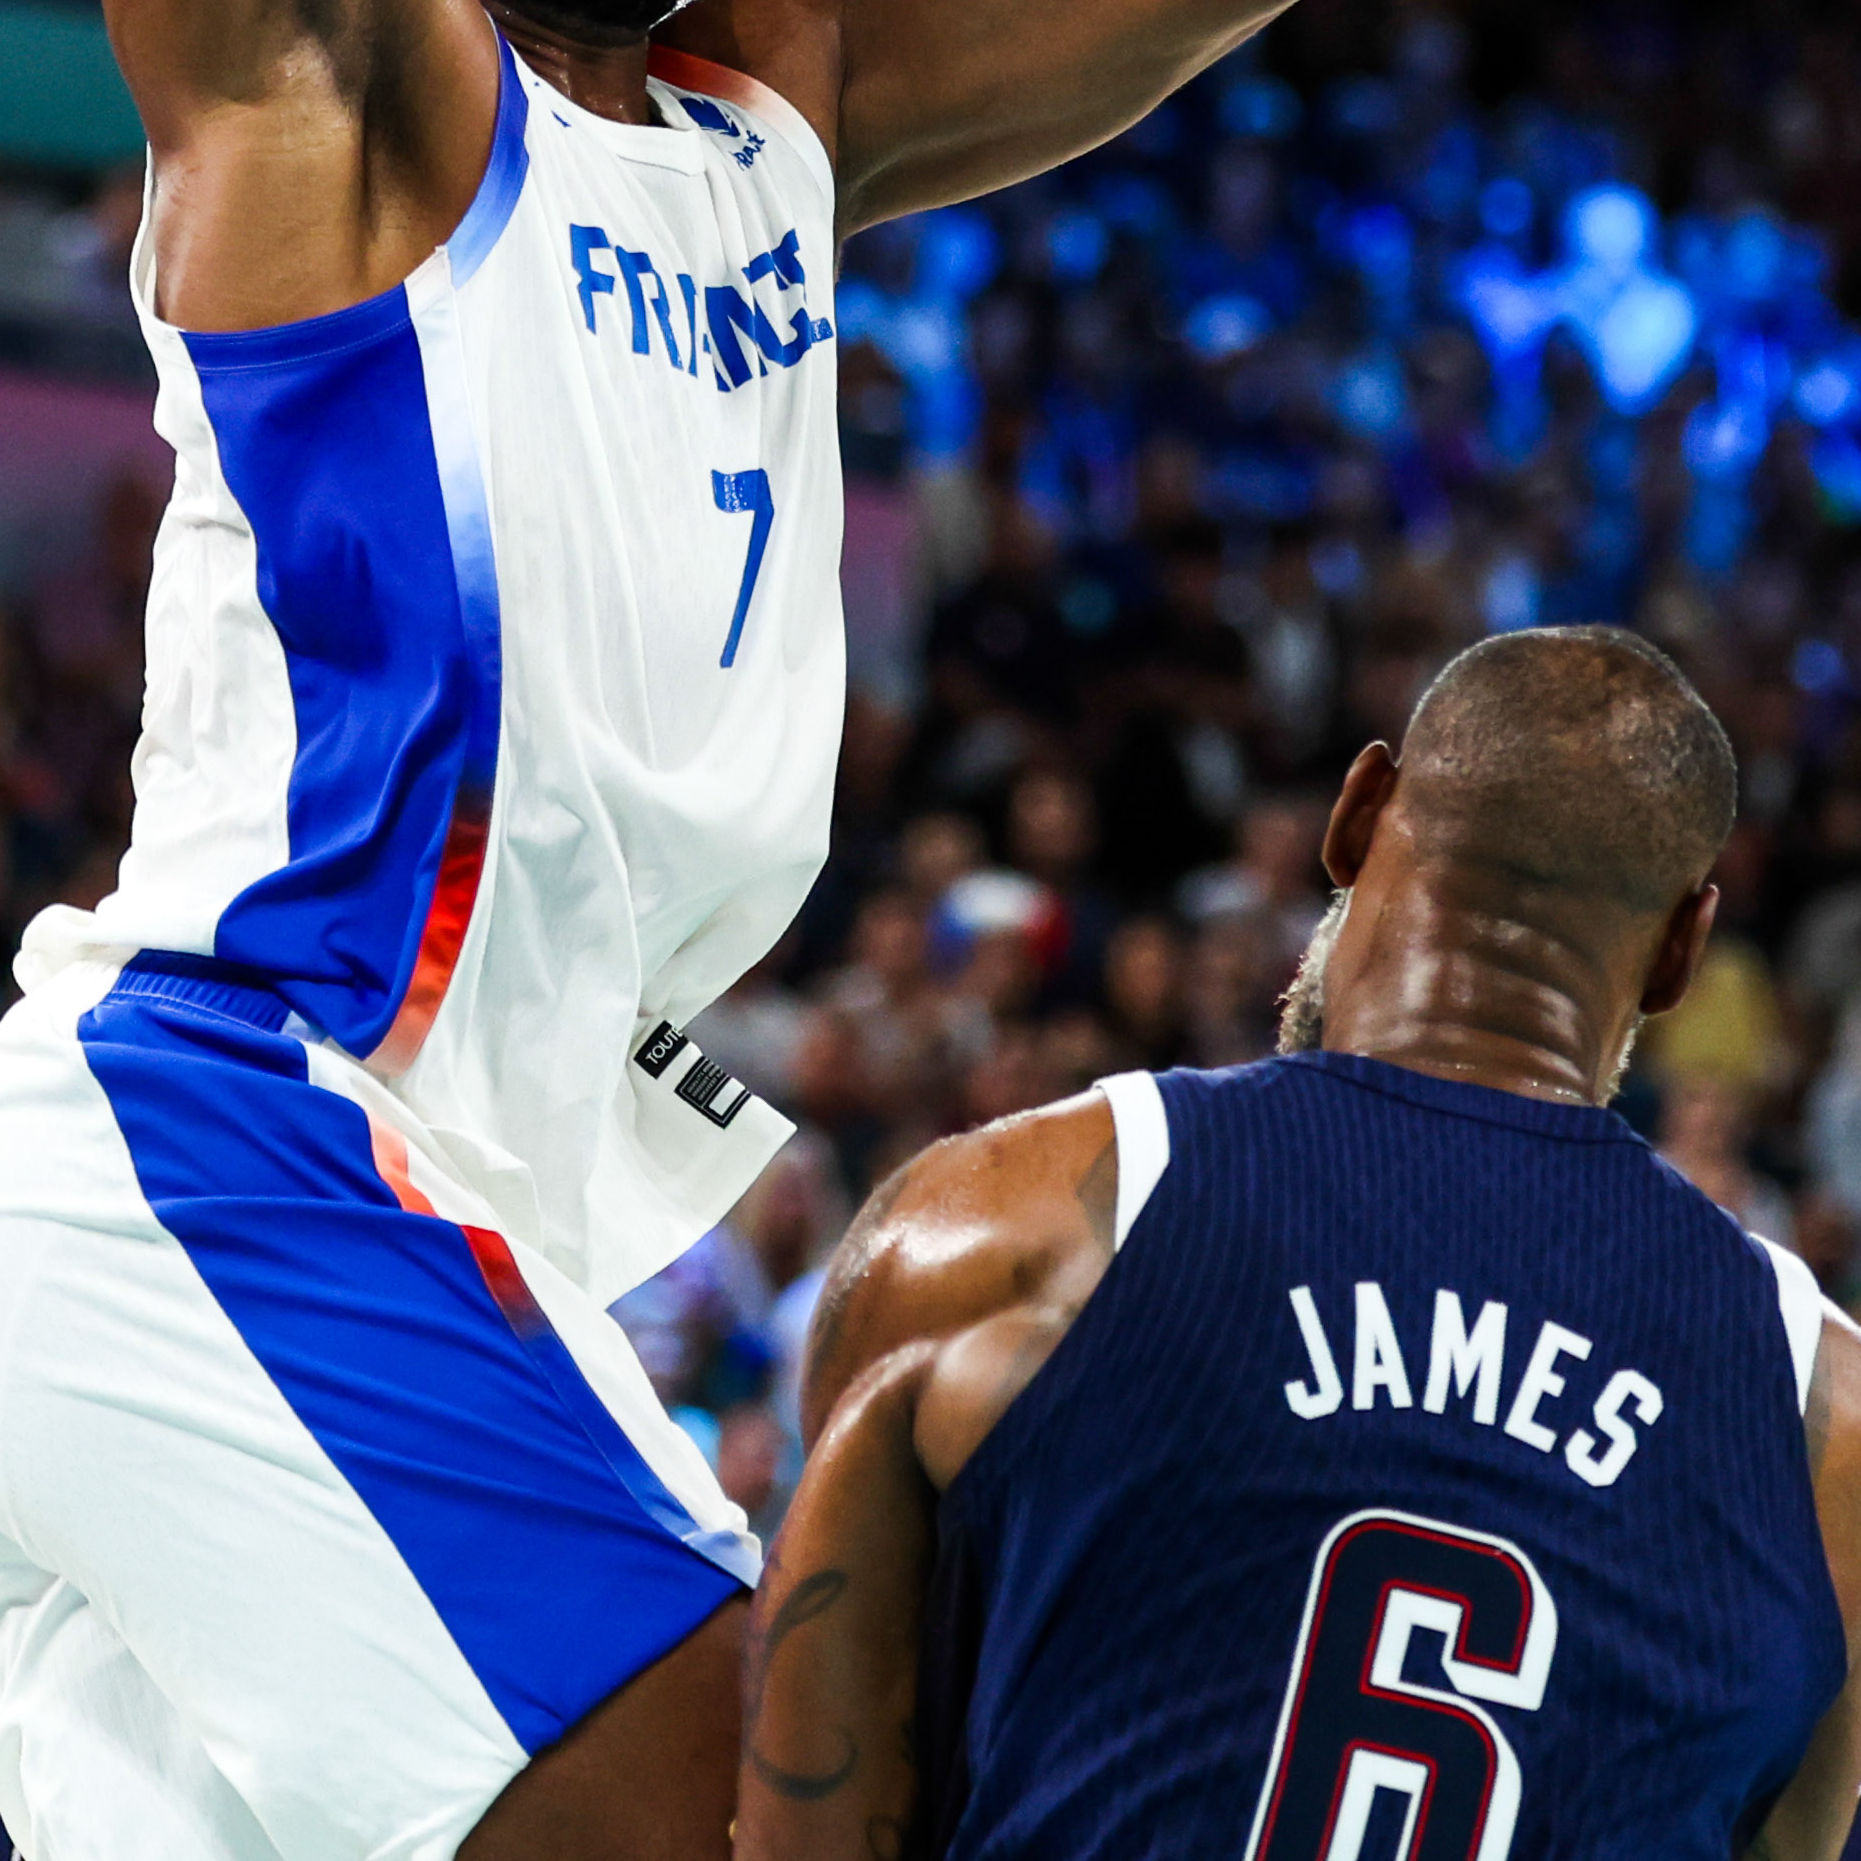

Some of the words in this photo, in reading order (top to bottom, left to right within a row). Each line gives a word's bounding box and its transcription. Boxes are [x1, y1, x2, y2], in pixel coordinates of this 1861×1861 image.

[711, 468, 775, 669] 7
[1284, 1281, 1664, 1487] JAMES
[1244, 1507, 1559, 1861] 6
